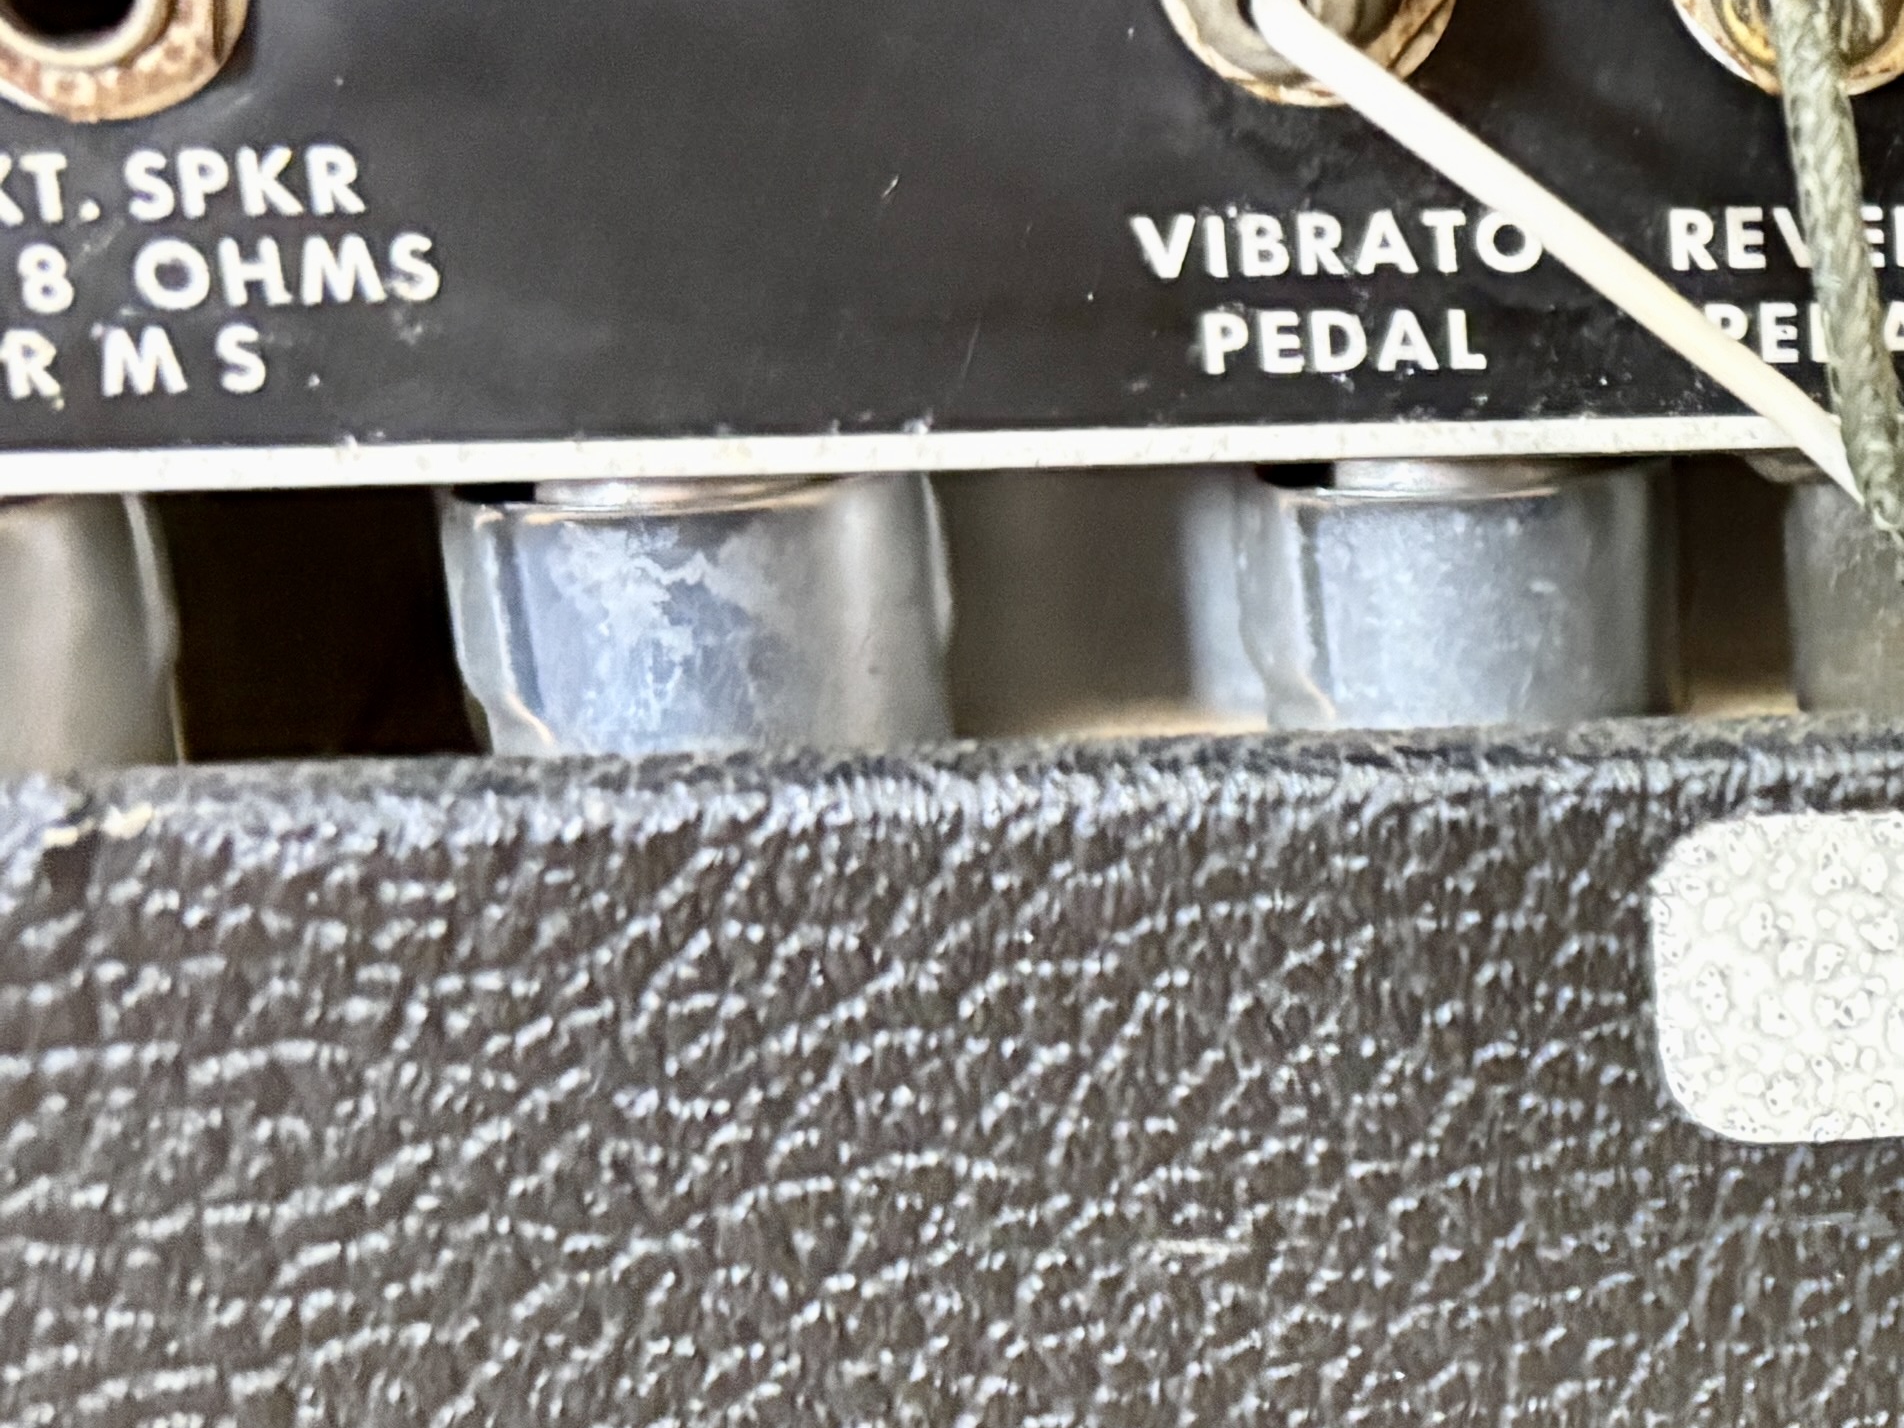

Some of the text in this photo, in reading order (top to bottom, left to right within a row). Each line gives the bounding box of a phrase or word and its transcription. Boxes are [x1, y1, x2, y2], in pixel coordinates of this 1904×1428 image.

[124, 144, 366, 222] SPKR
[17, 232, 441, 314] 8 OHMS
[1130, 209, 1543, 279] VIBRATO
[1198, 308, 1487, 374] PEDAL
